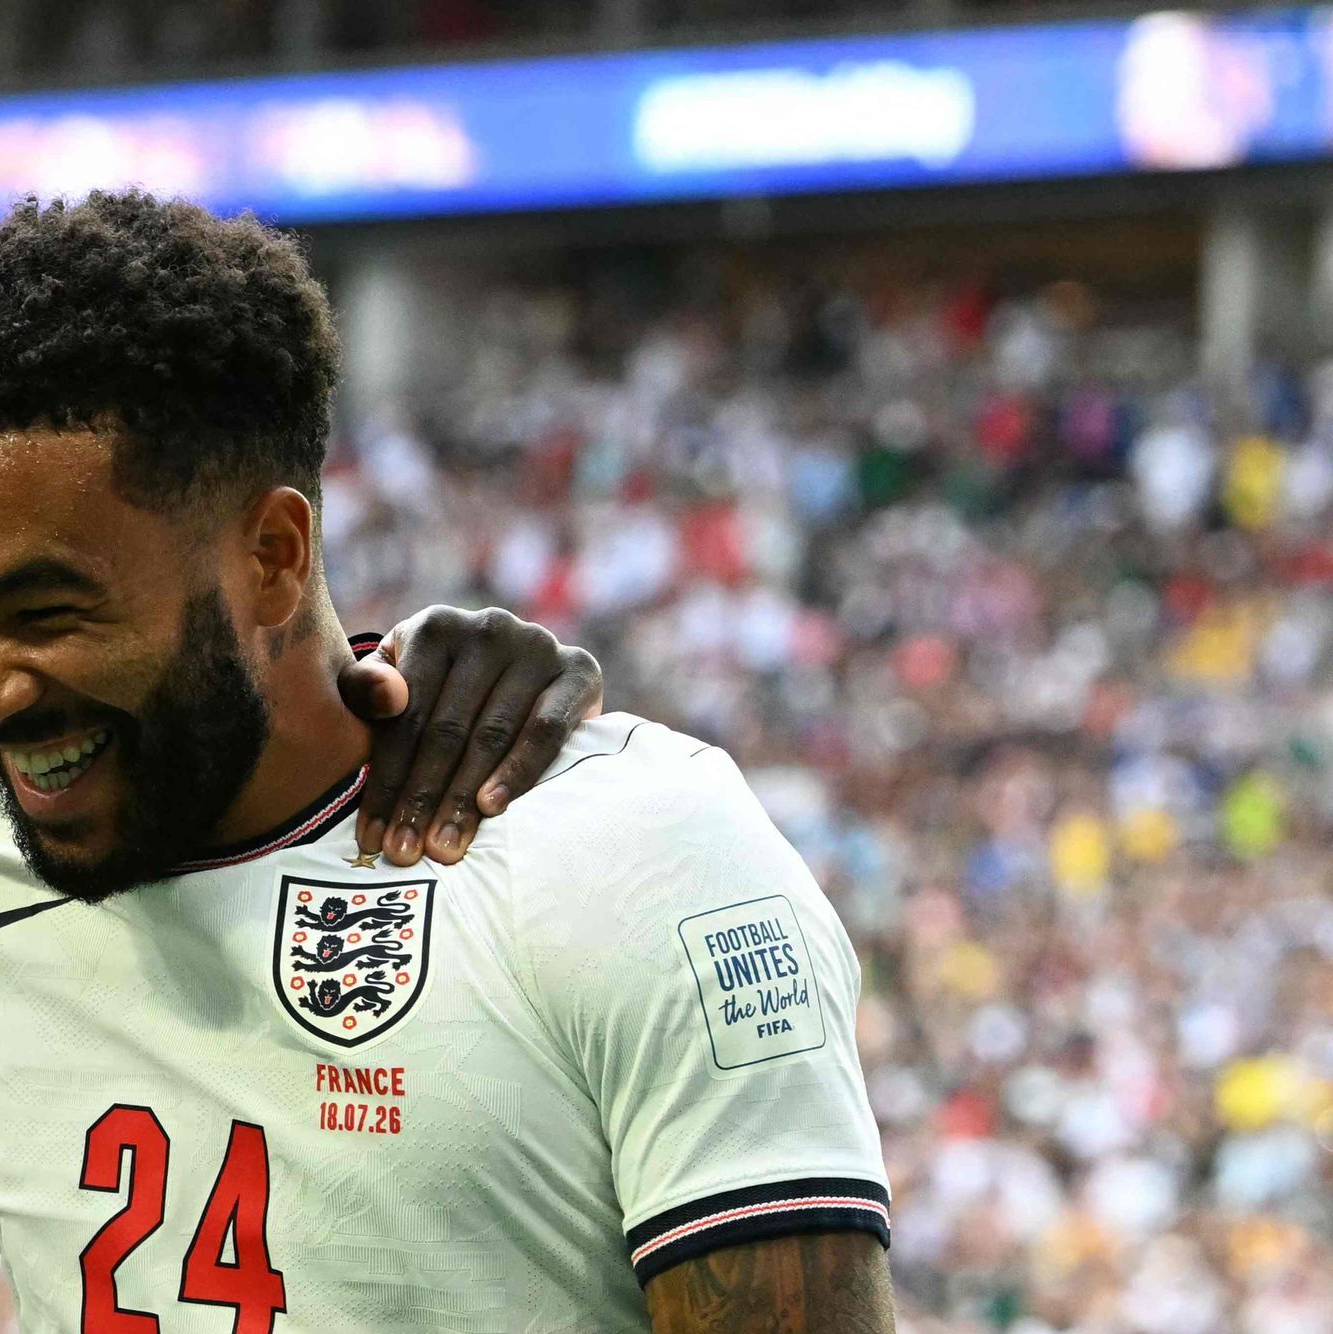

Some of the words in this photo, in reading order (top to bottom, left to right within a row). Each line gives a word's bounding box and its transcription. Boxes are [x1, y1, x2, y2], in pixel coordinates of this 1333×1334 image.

[704, 918, 788, 957] FOOTBALL
[714, 943, 799, 991] UNITES
[718, 994, 756, 1026] the
[757, 978, 810, 1016] World
[757, 1018, 793, 1038] FIFA
[316, 1064, 405, 1096] FRANCE
[320, 1102, 401, 1134] 18.07.26
